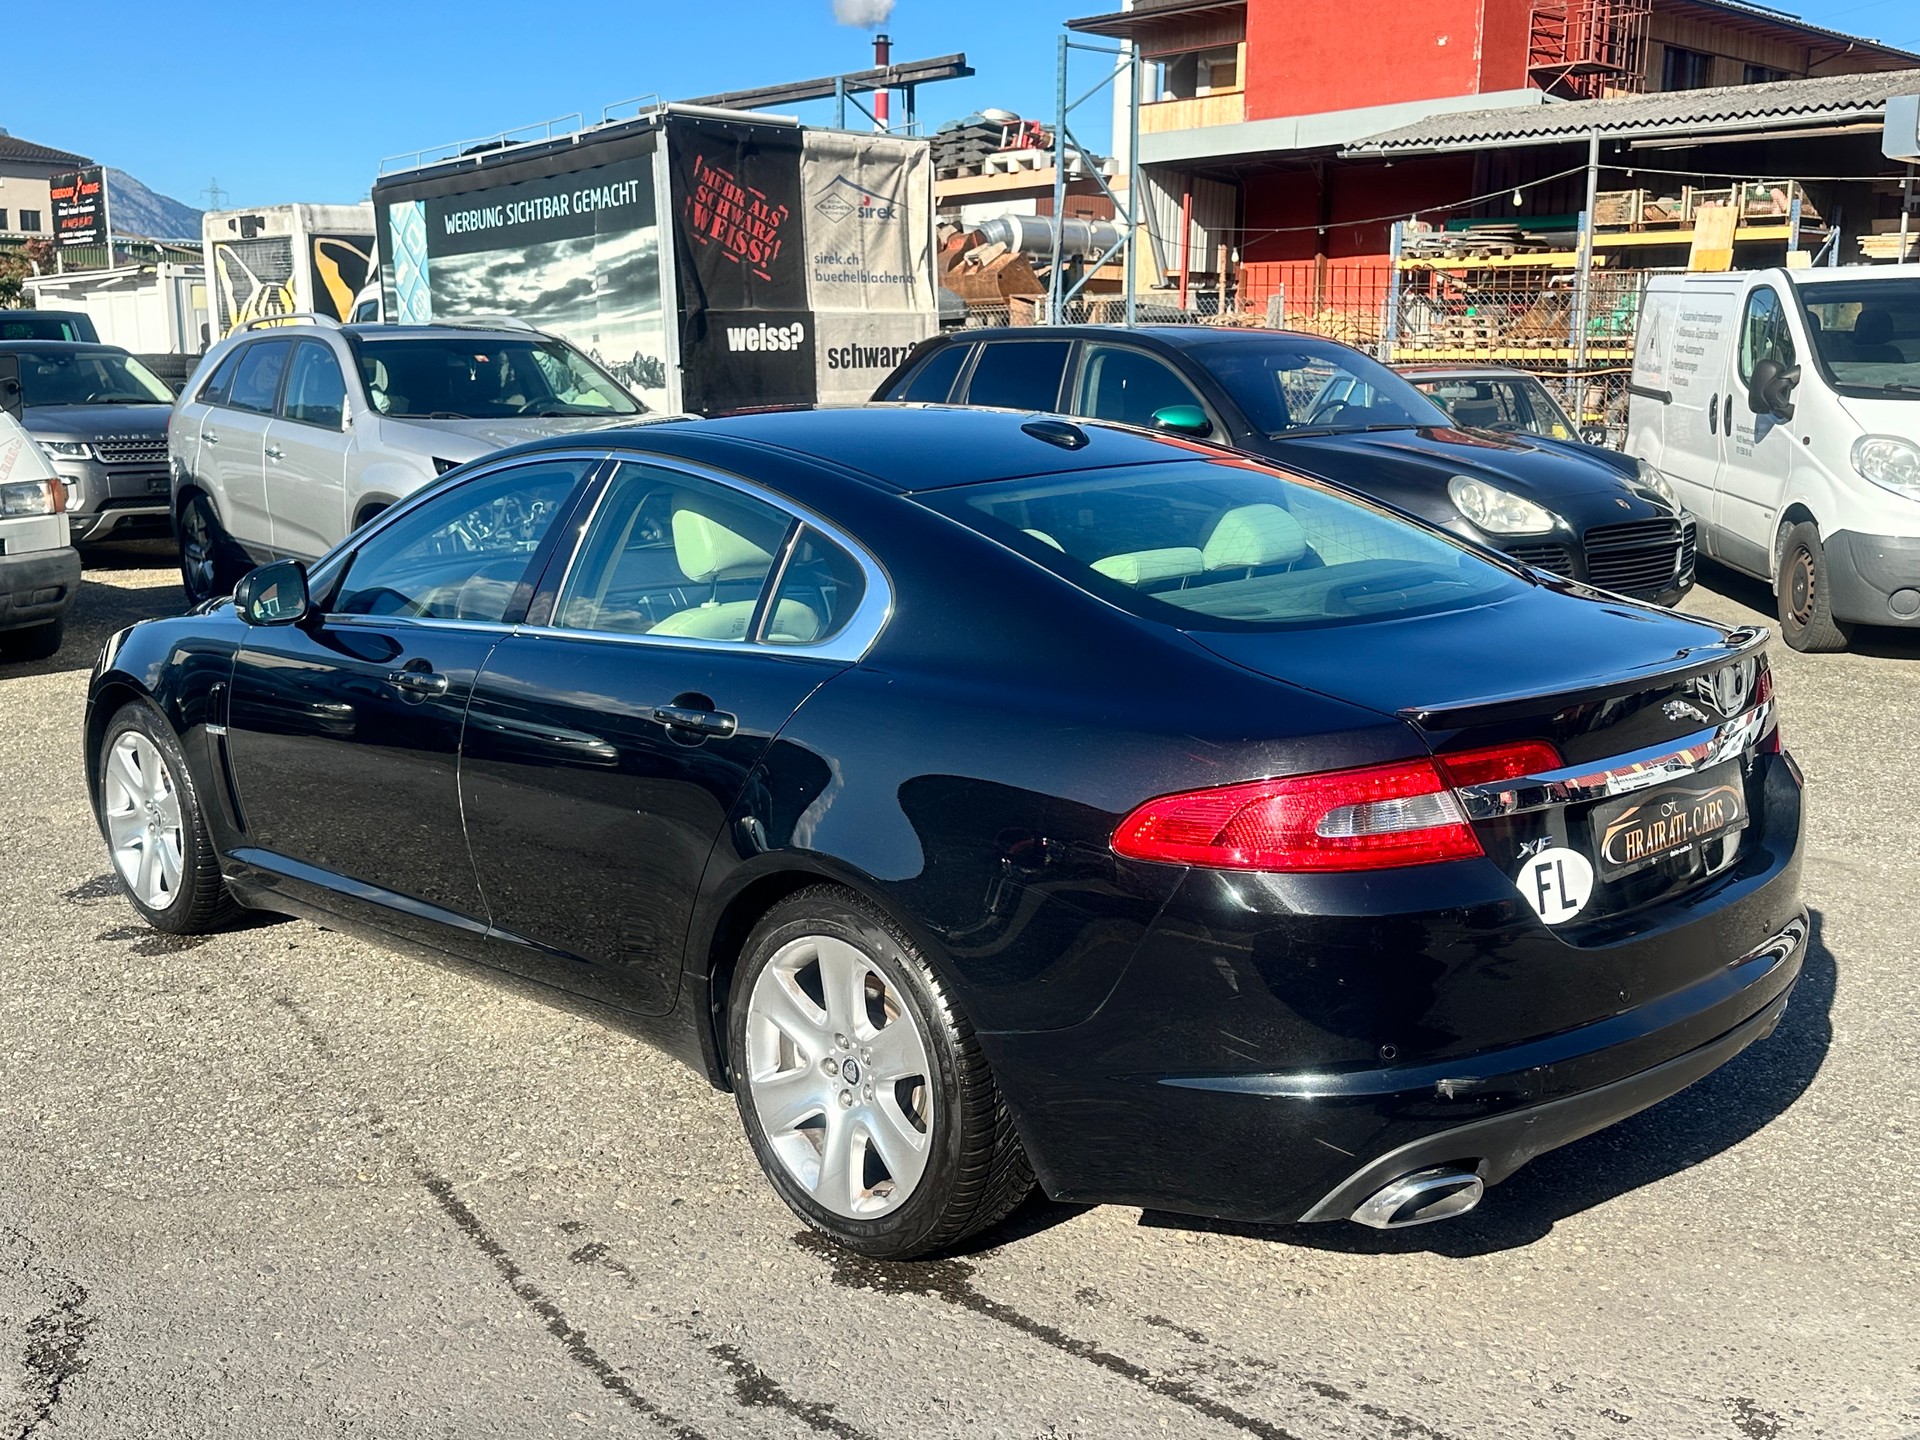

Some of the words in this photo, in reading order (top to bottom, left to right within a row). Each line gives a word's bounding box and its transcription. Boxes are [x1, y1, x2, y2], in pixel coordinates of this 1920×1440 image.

[444, 206, 503, 235] WERBUNG
[506, 194, 570, 226] SICHTBAR
[573, 180, 639, 214] GEMACHT
[695, 185, 777, 245] SCHWARZ
[701, 166, 746, 207] MEHR
[748, 200, 781, 227] ALS
[857, 196, 897, 219] sirek
[694, 201, 771, 268] WEISS!
[814, 252, 859, 265] sirek.ch
[727, 322, 804, 351] weiss?
[1516, 834, 1553, 859] XF
[1535, 859, 1577, 915] FL
